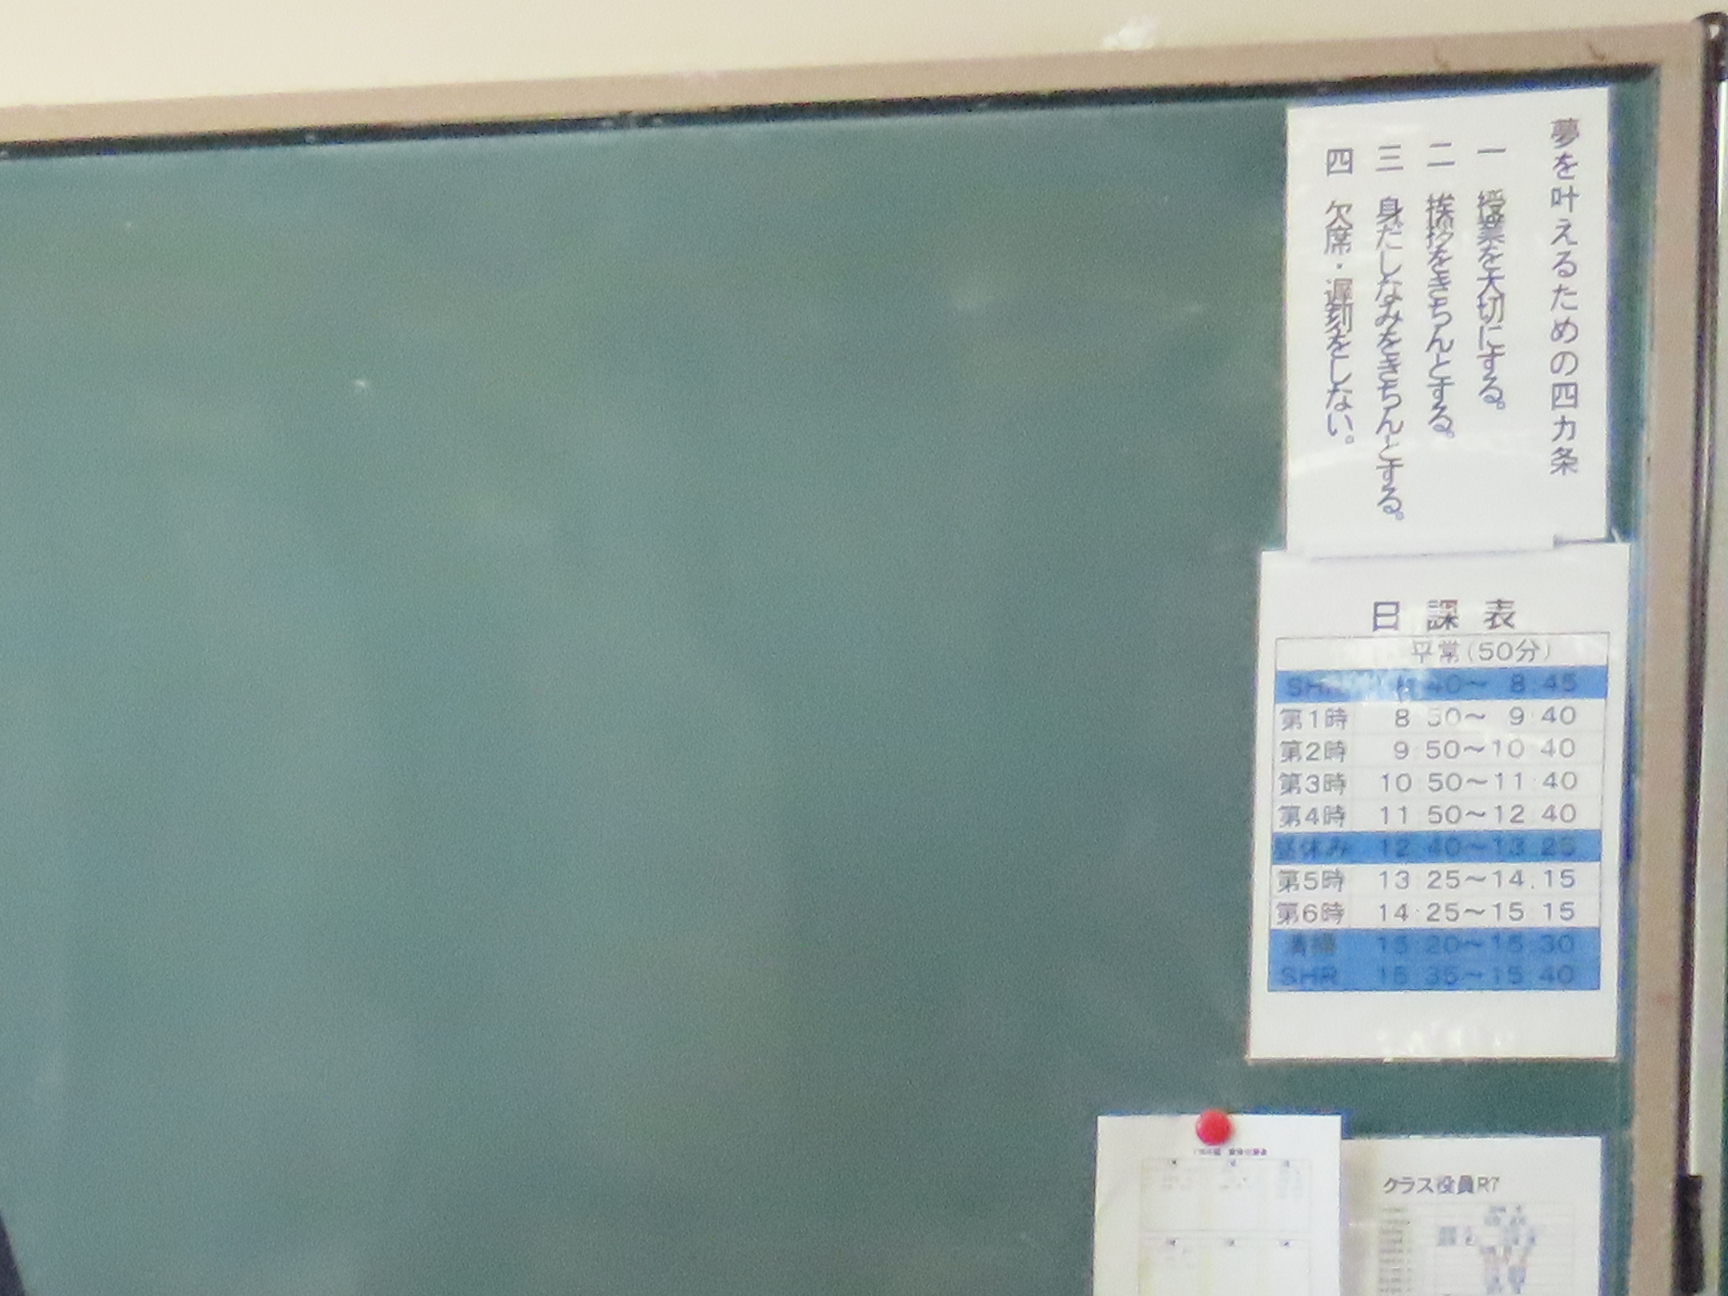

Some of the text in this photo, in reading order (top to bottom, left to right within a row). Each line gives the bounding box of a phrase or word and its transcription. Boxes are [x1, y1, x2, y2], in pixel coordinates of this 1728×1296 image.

[1375, 196, 1405, 520] 身だしなみをきちんとする。
[1476, 189, 1507, 410] 授業を大切にする。
[1372, 599, 1516, 632] 日課表
